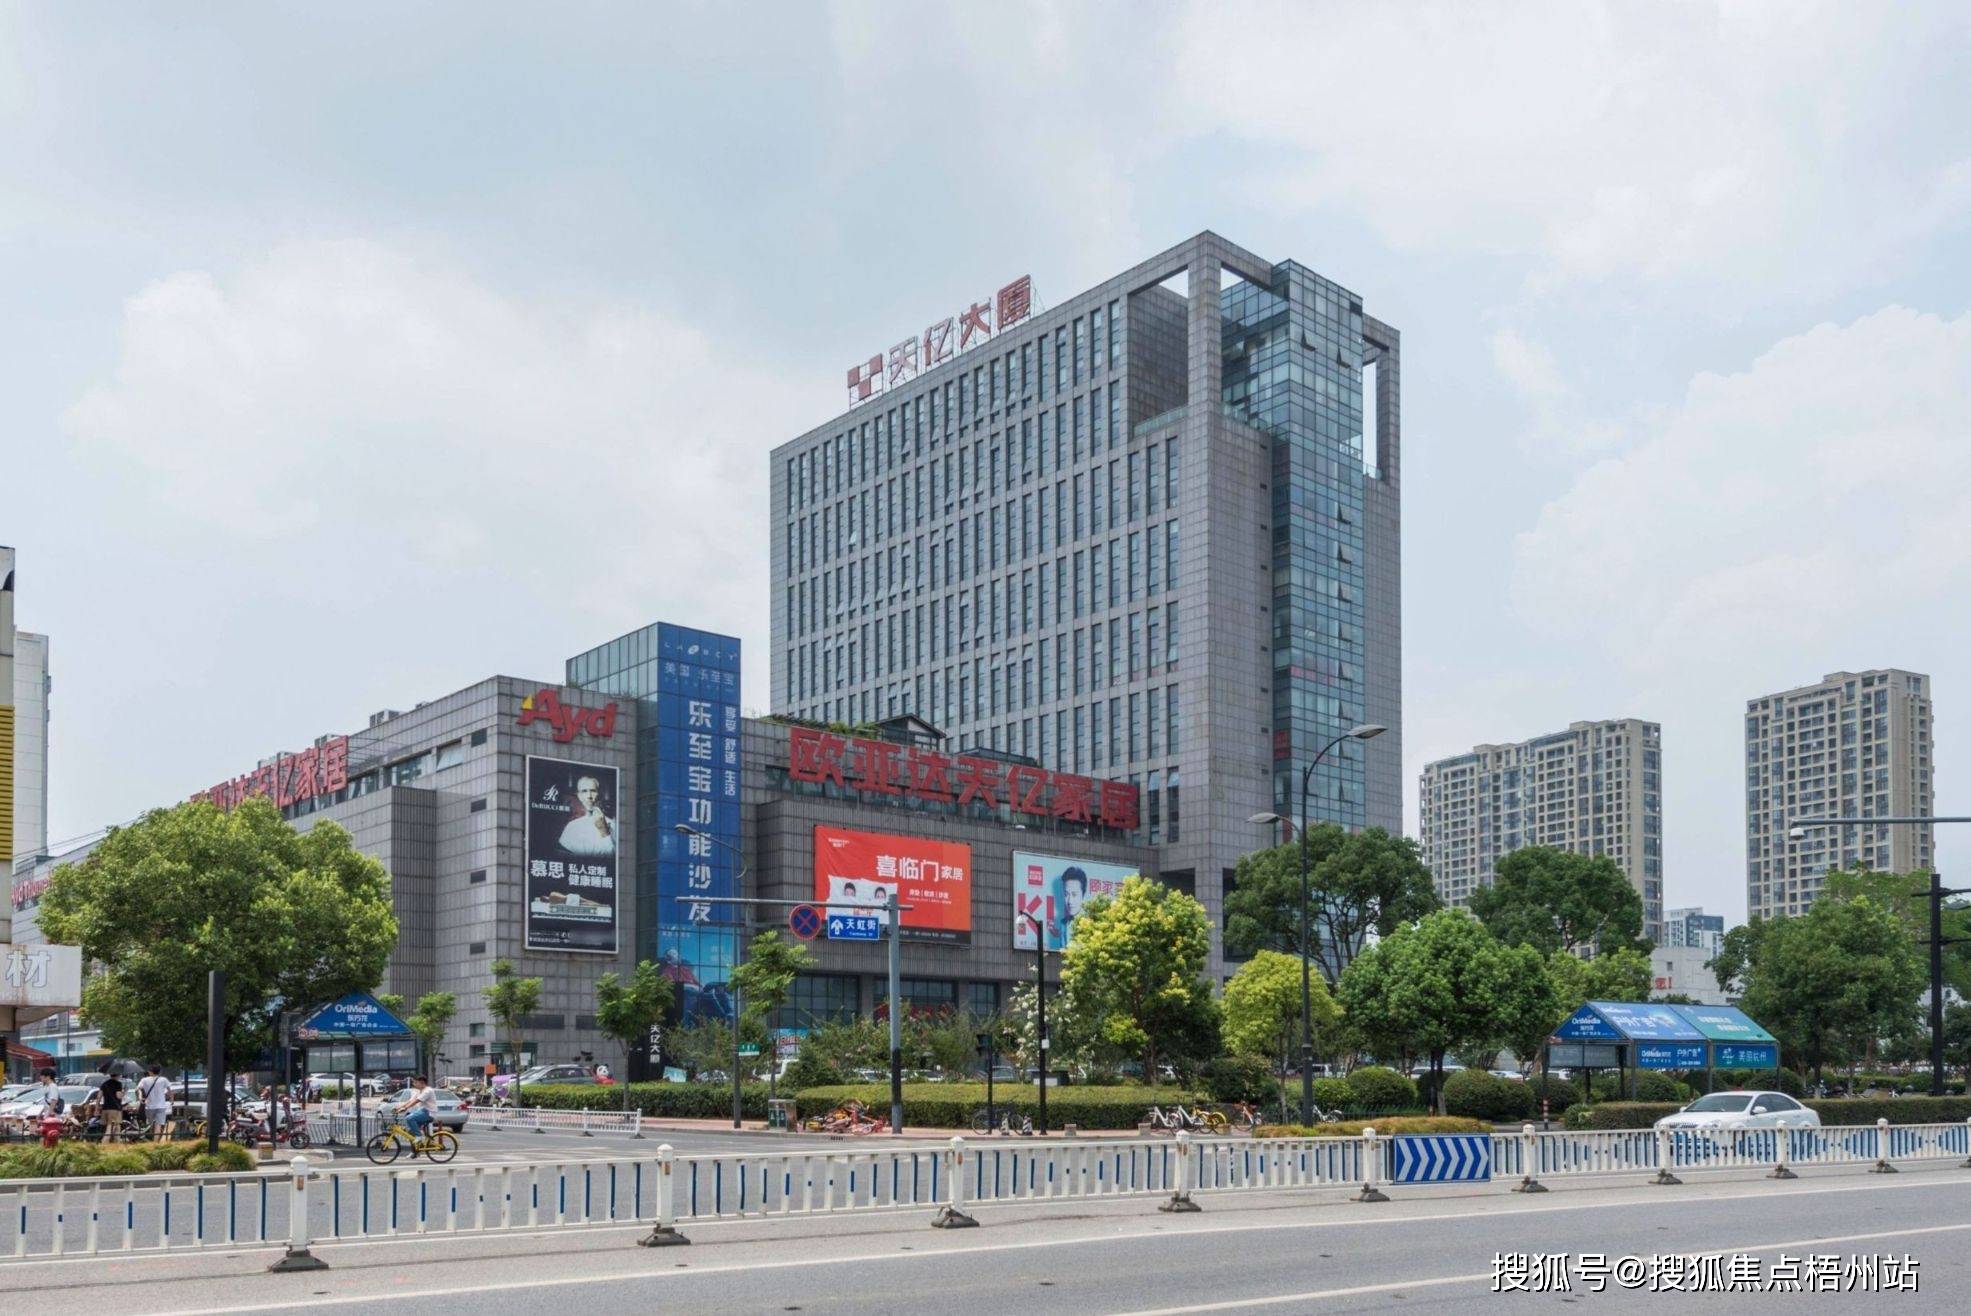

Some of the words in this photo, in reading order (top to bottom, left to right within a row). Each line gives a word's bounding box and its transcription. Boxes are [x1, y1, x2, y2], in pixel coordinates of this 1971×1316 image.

[888, 274, 1031, 384] 天亿大厦
[517, 688, 618, 744] Ayd
[790, 727, 1140, 829] 欧亚达天亿家居
[688, 701, 712, 922] 乐至宝功能沙发
[530, 860, 565, 879] 慕思
[568, 863, 607, 877] 私人定制
[568, 874, 613, 889] 健康睡眠
[846, 918, 876, 930] 天虹街
[5, 949, 51, 988] 材
[335, 1004, 378, 1014] OriMedia
